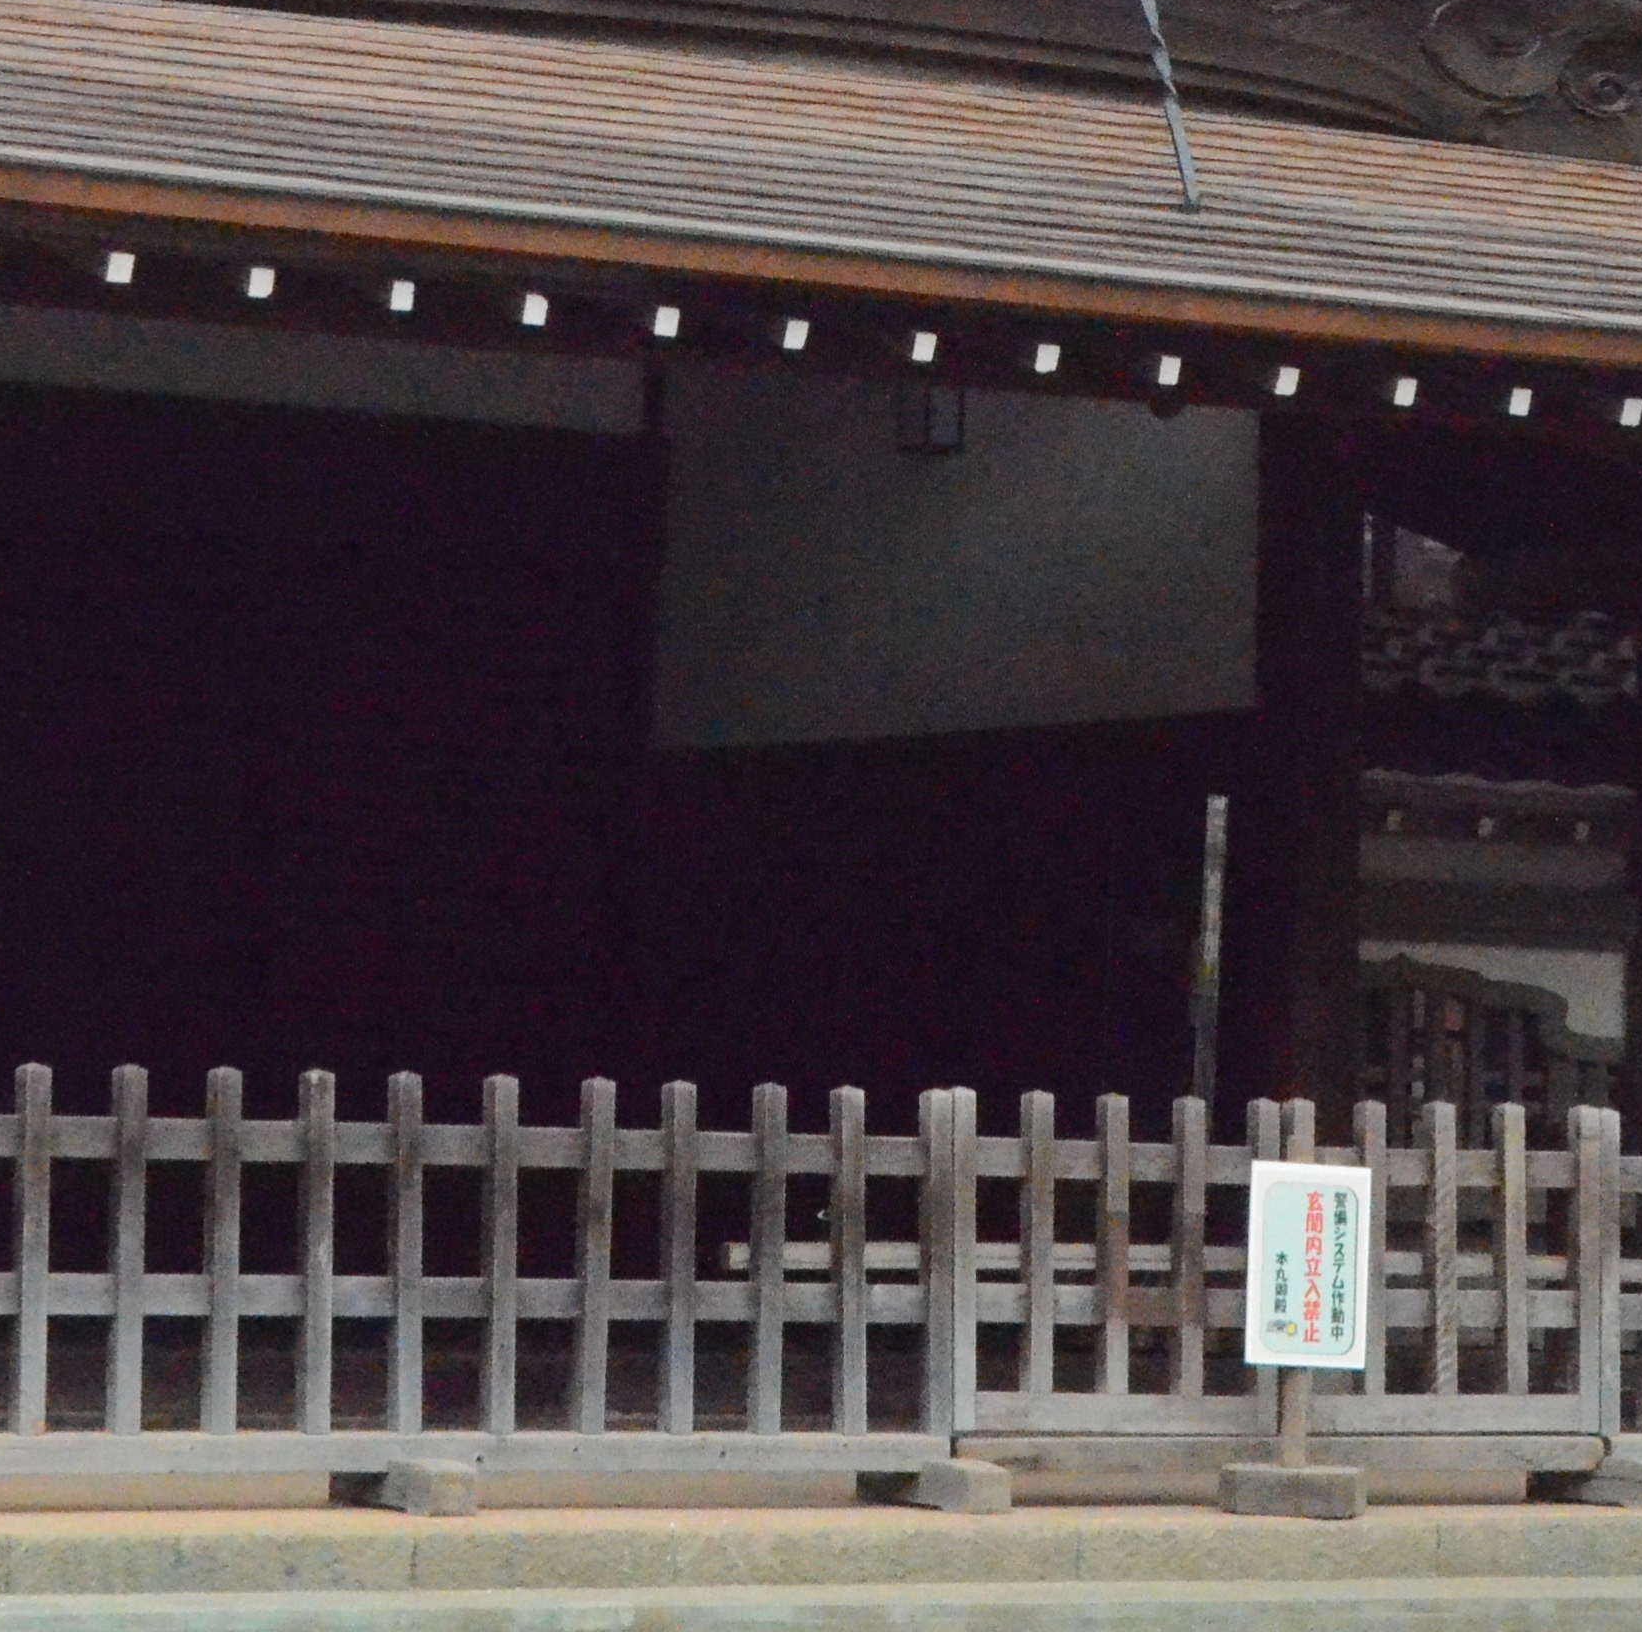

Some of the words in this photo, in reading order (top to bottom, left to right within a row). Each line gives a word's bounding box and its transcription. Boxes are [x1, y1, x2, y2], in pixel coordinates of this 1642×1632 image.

[1274, 1251, 1288, 1313] 本丸御殿
[1303, 1191, 1324, 1343] 玄関内立入禁止
[1331, 1192, 1348, 1340] 警備システム作動中
